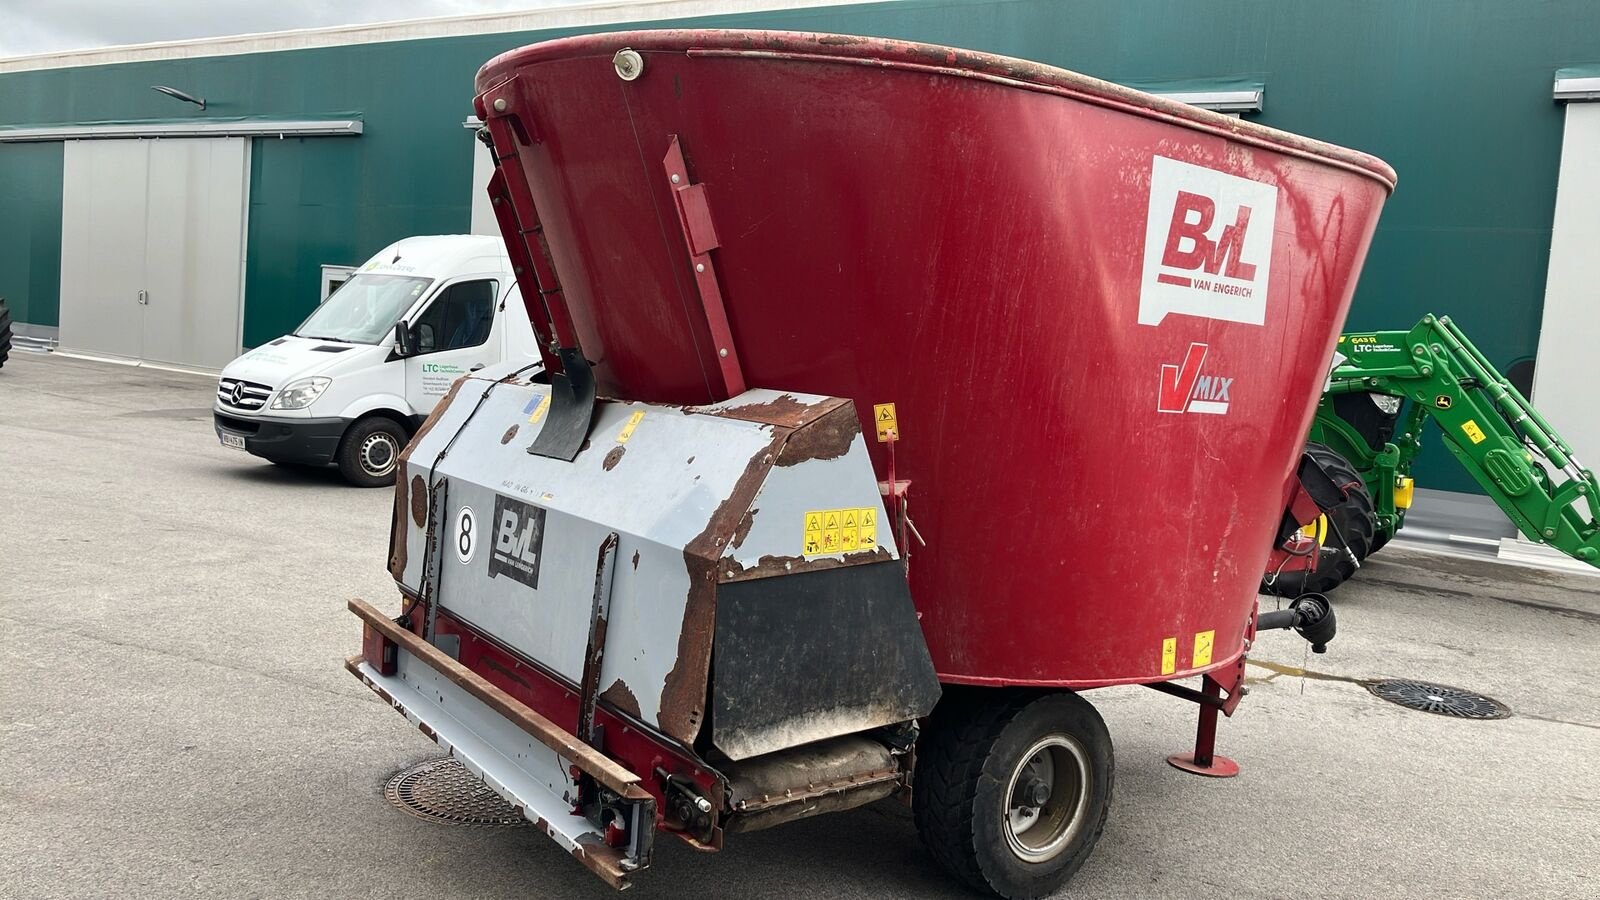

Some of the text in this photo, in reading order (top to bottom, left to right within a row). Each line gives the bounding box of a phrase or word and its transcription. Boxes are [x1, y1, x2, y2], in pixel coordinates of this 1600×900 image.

[1194, 279, 1253, 298] VAN ENGERICH
[1354, 344, 1372, 352] LTC
[422, 364, 439, 373] LTC
[1193, 375, 1233, 401] MIX
[459, 514, 472, 555] 8
